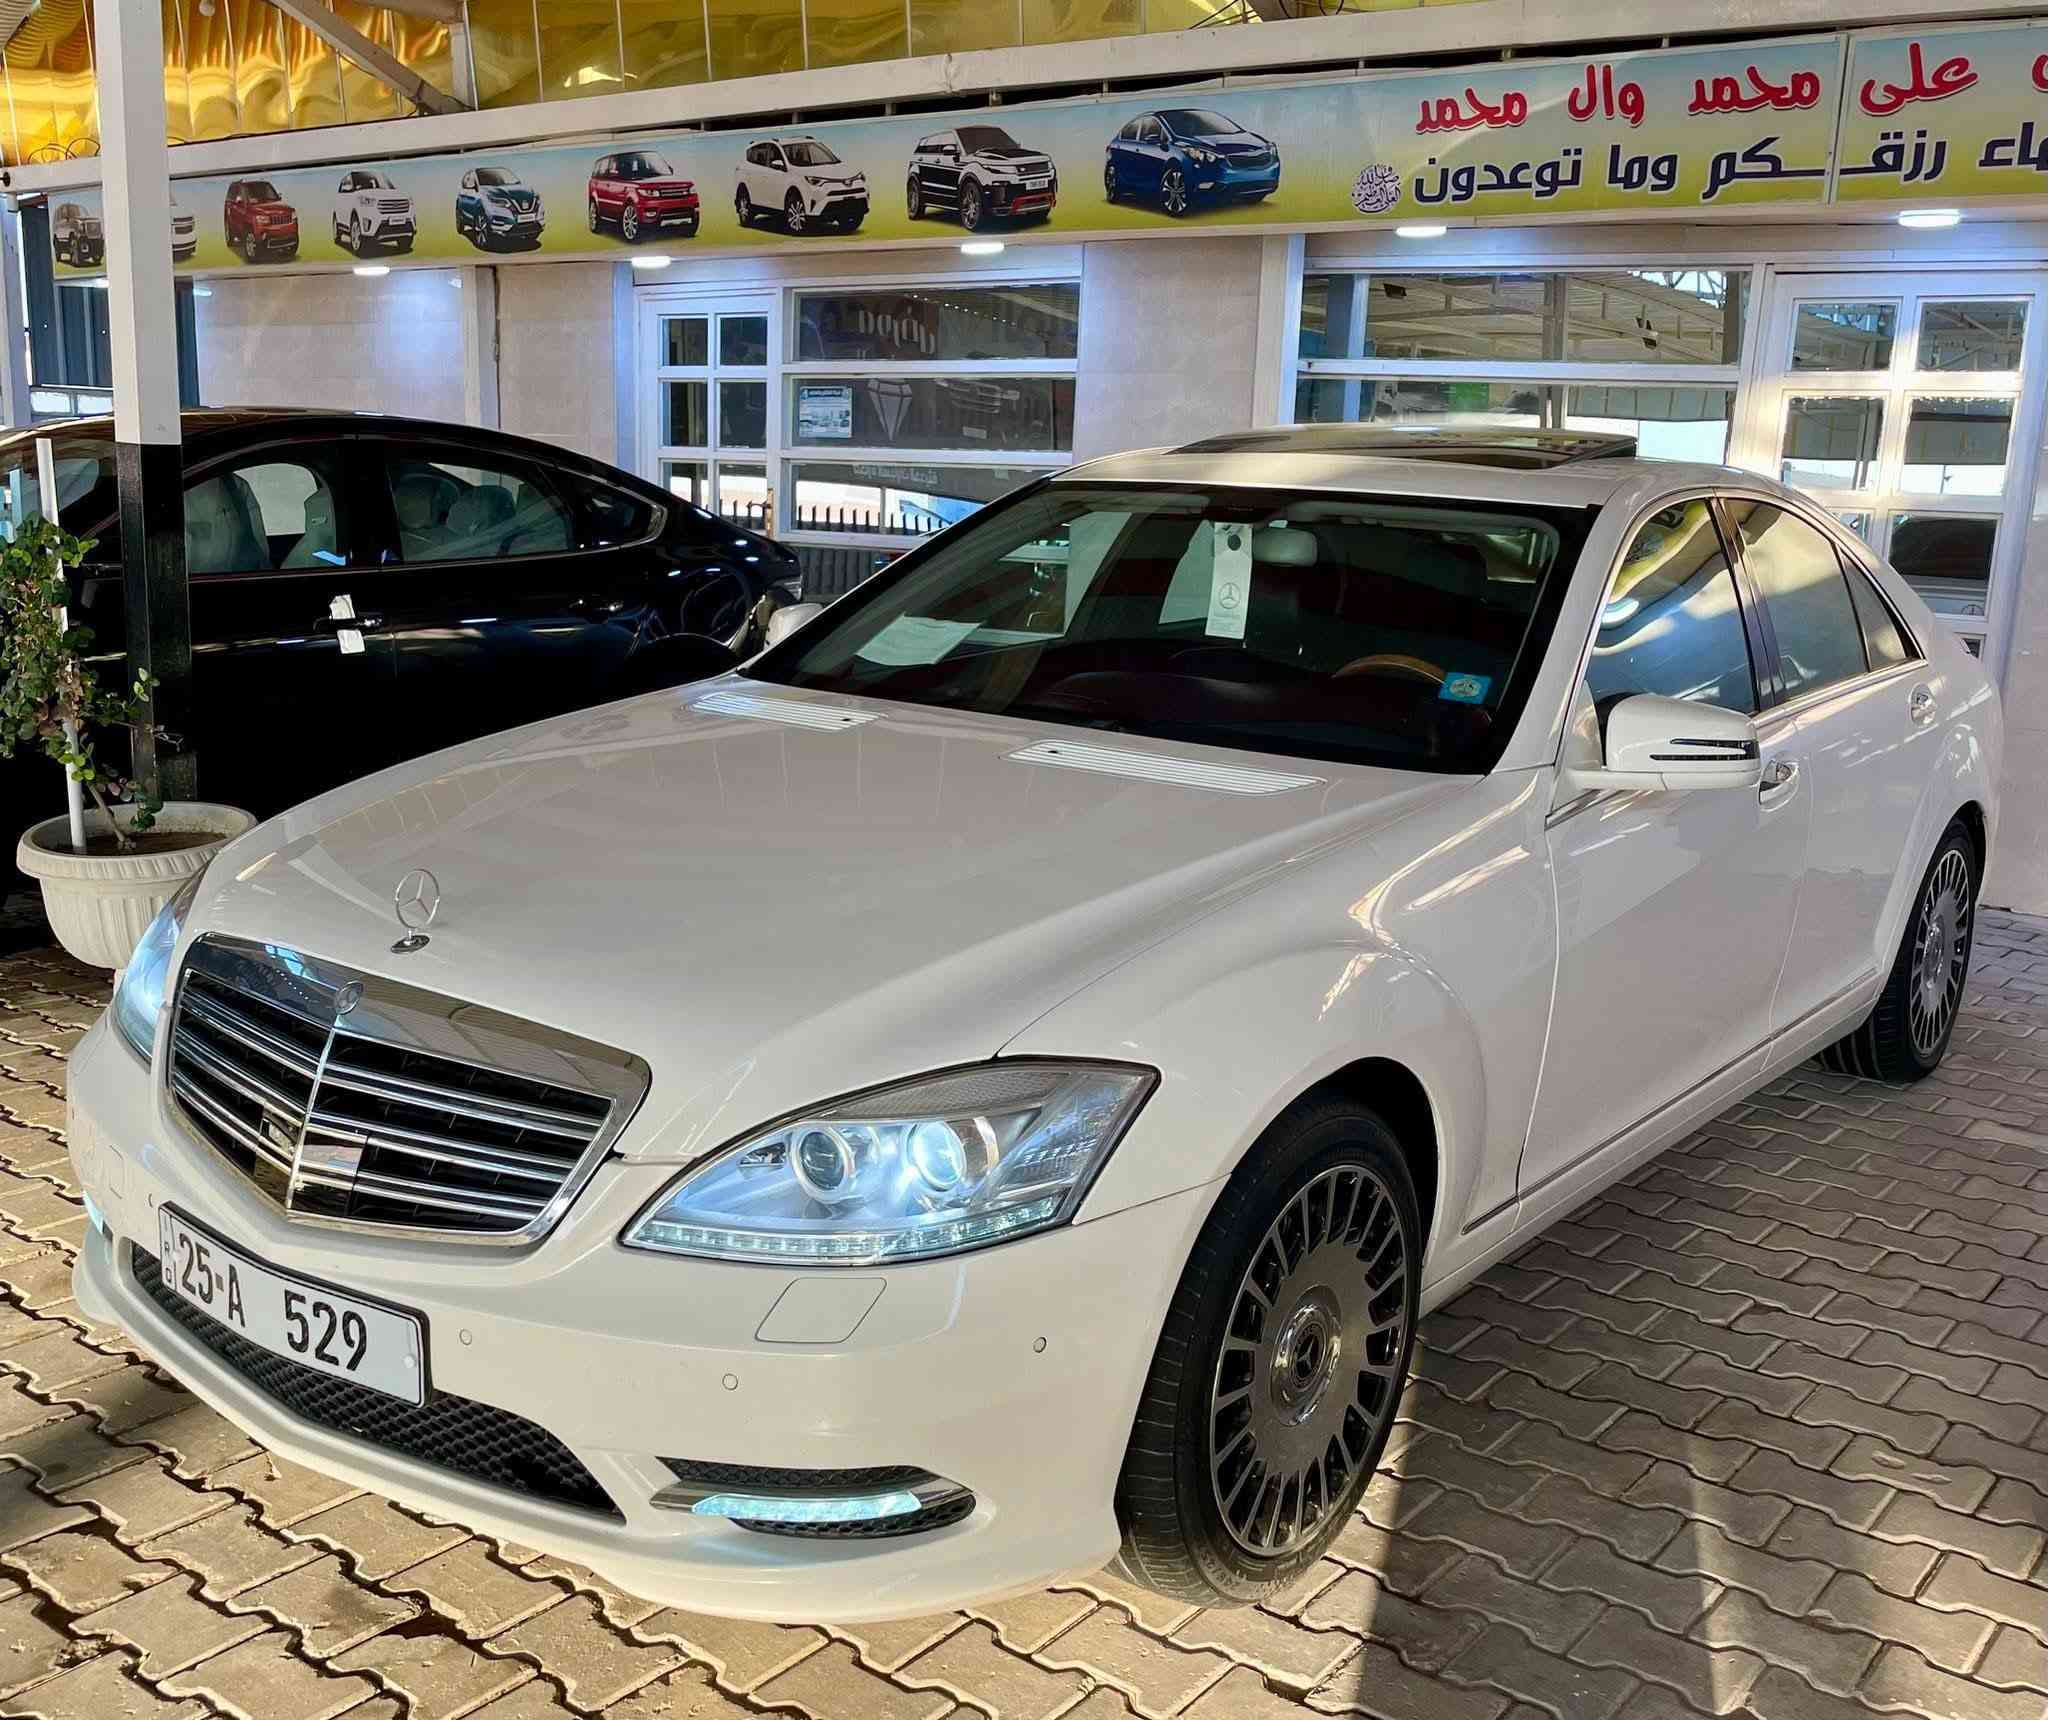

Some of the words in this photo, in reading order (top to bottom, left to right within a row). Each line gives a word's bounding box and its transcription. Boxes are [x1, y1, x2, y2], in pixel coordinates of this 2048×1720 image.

[1688, 66, 1820, 113] محمد
[1861, 43, 1978, 114] على
[1415, 88, 1528, 132] محمد
[1415, 148, 1583, 202] توعدون
[1608, 144, 1678, 192] وما
[284, 1288, 367, 1372] 529
